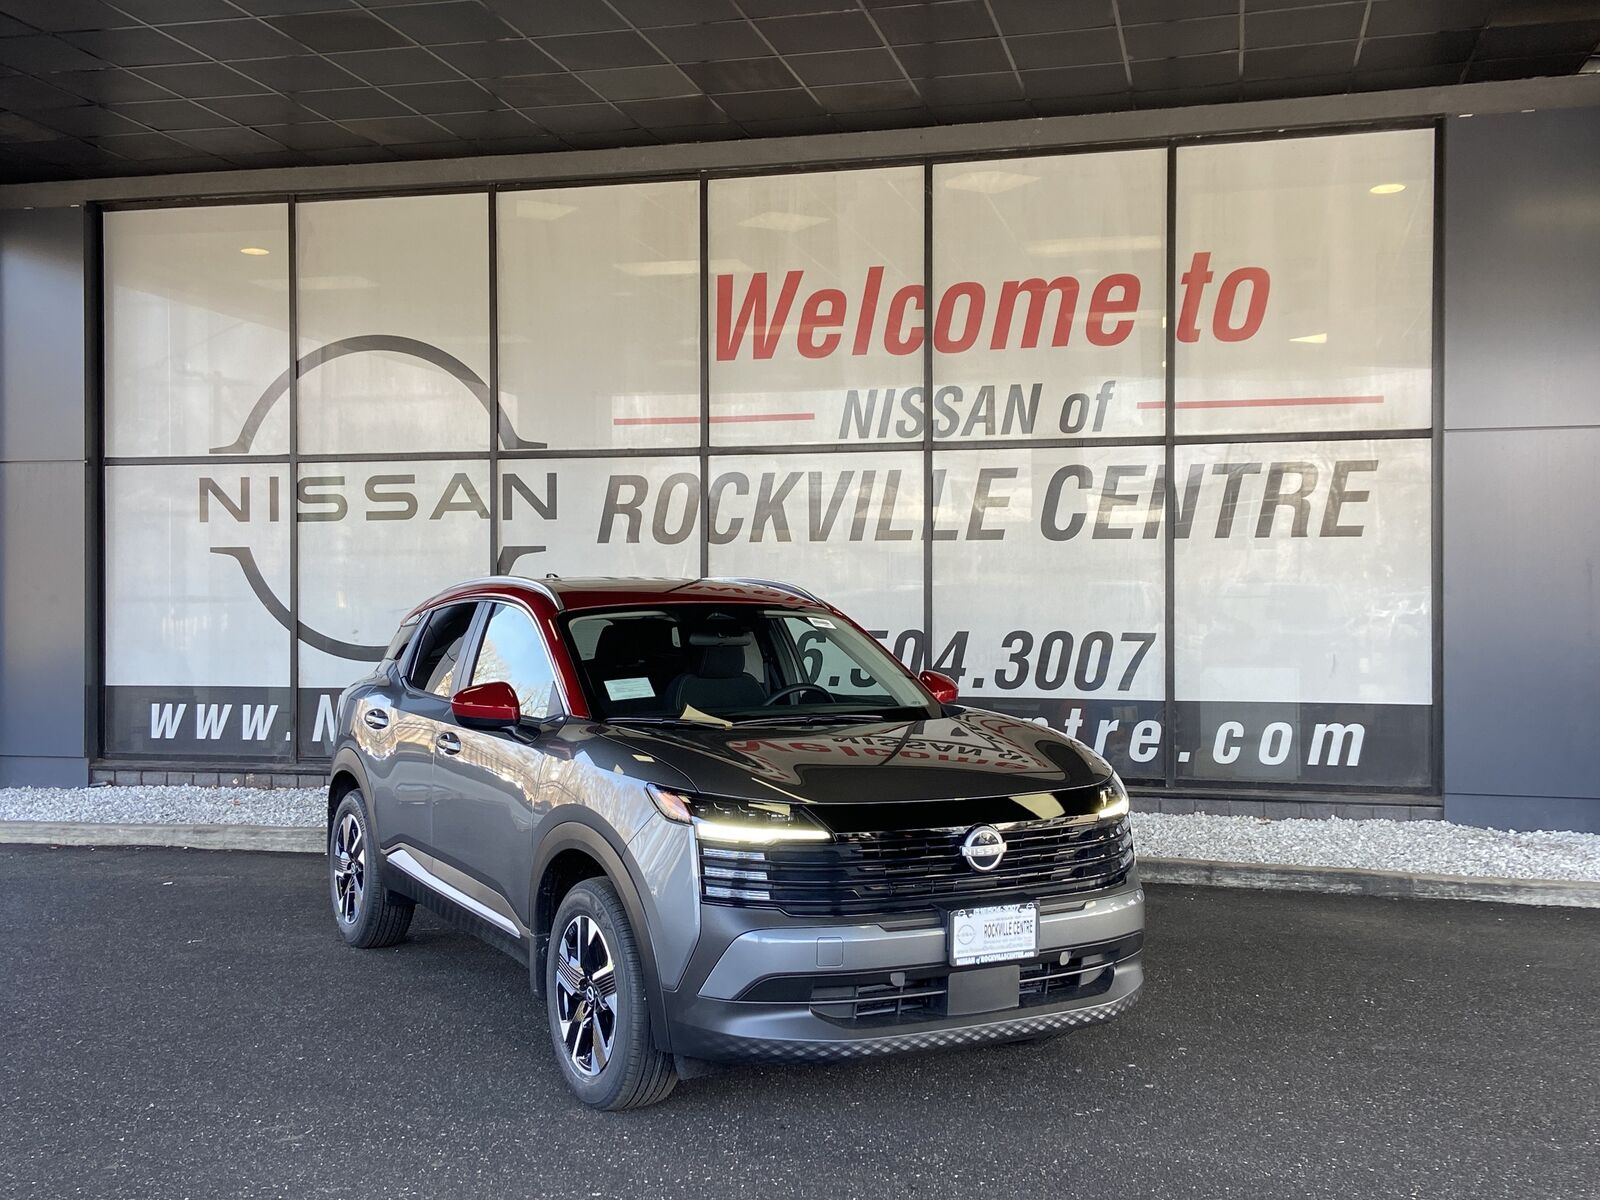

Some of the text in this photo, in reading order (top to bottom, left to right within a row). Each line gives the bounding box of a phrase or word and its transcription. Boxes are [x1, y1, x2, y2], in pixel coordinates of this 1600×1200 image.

[716, 252, 1271, 361] Welcome to
[838, 380, 1116, 440] NISSAN of
[199, 472, 557, 523] NISSAN
[597, 460, 1379, 545] ROCKVILLE CENTRE
[984, 922, 1012, 938] ROCKVILLE
[1014, 920, 1033, 935] CENTRE
